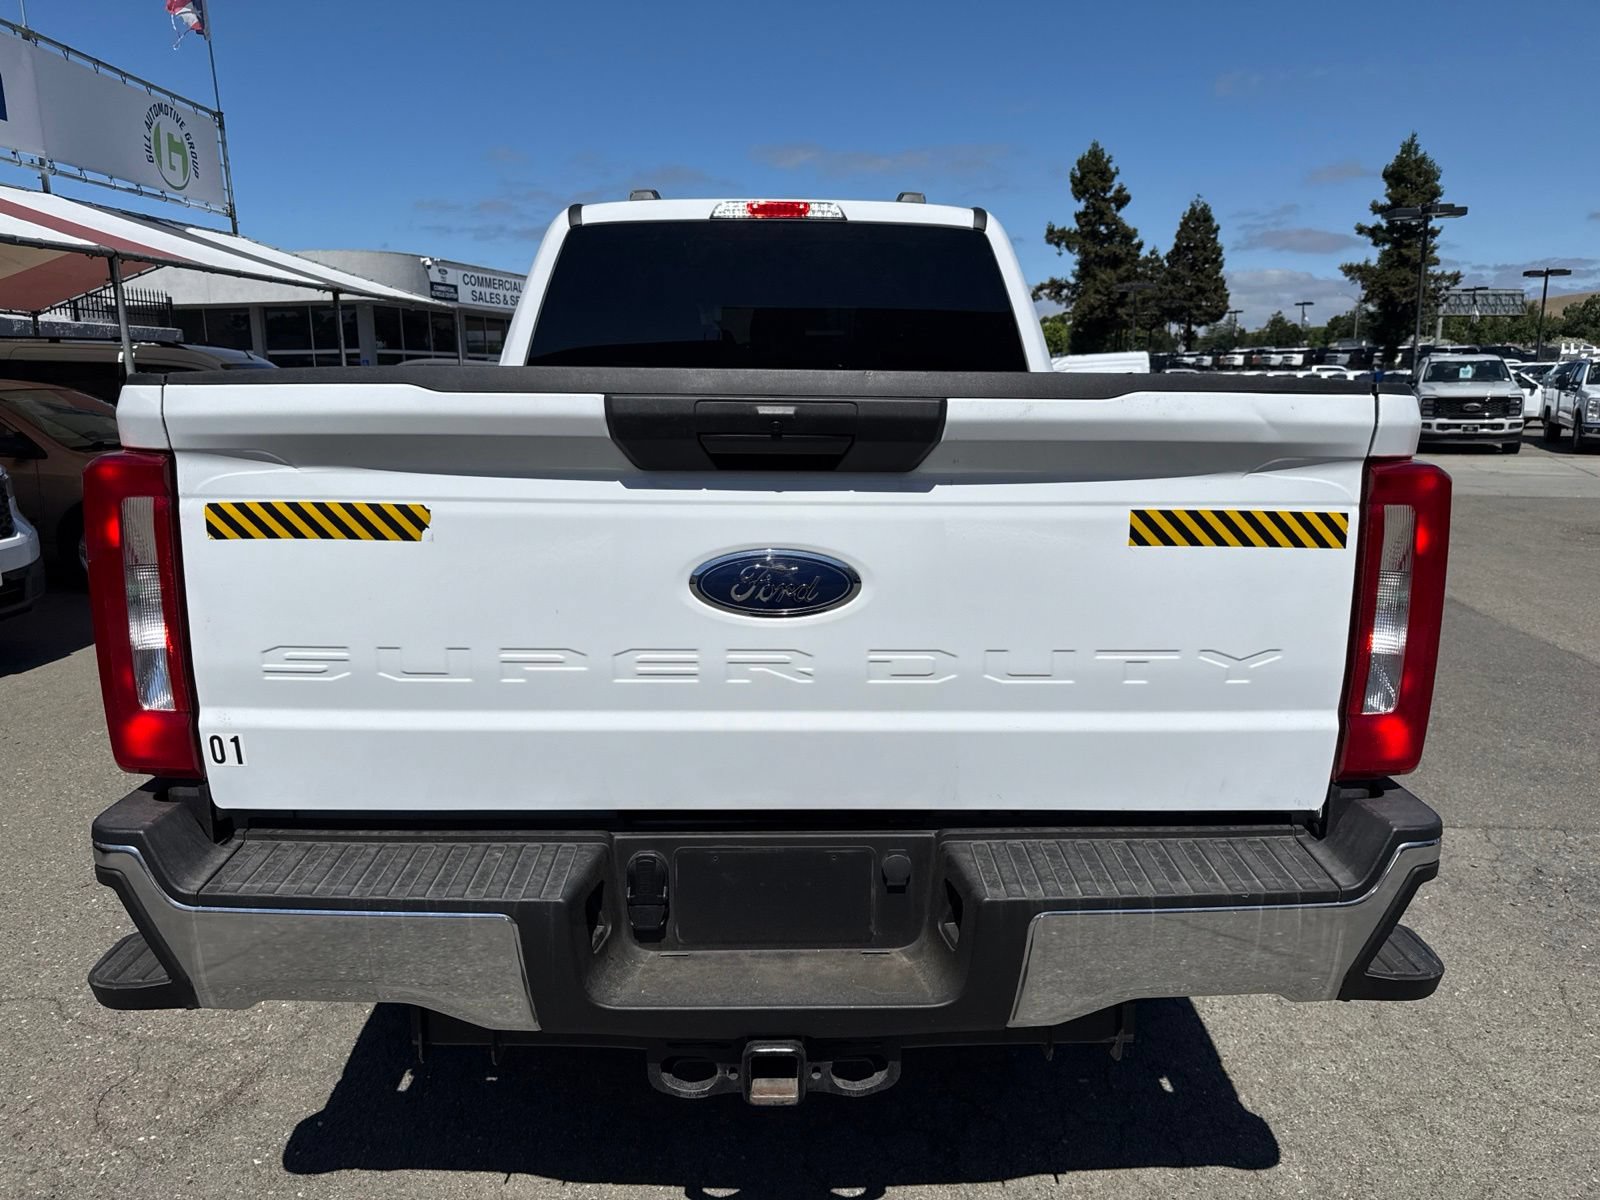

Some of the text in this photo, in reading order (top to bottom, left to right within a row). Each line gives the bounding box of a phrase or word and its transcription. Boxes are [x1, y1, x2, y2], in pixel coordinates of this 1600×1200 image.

[144, 102, 199, 179] GILL AUTOMOTIVE GROUP
[462, 273, 522, 293] COMMERCIAL
[471, 290, 501, 305] SALES
[503, 296, 508, 305] &
[730, 564, 821, 602] Ford
[262, 646, 1282, 683] SUPER DUTY
[209, 735, 243, 764] 01
